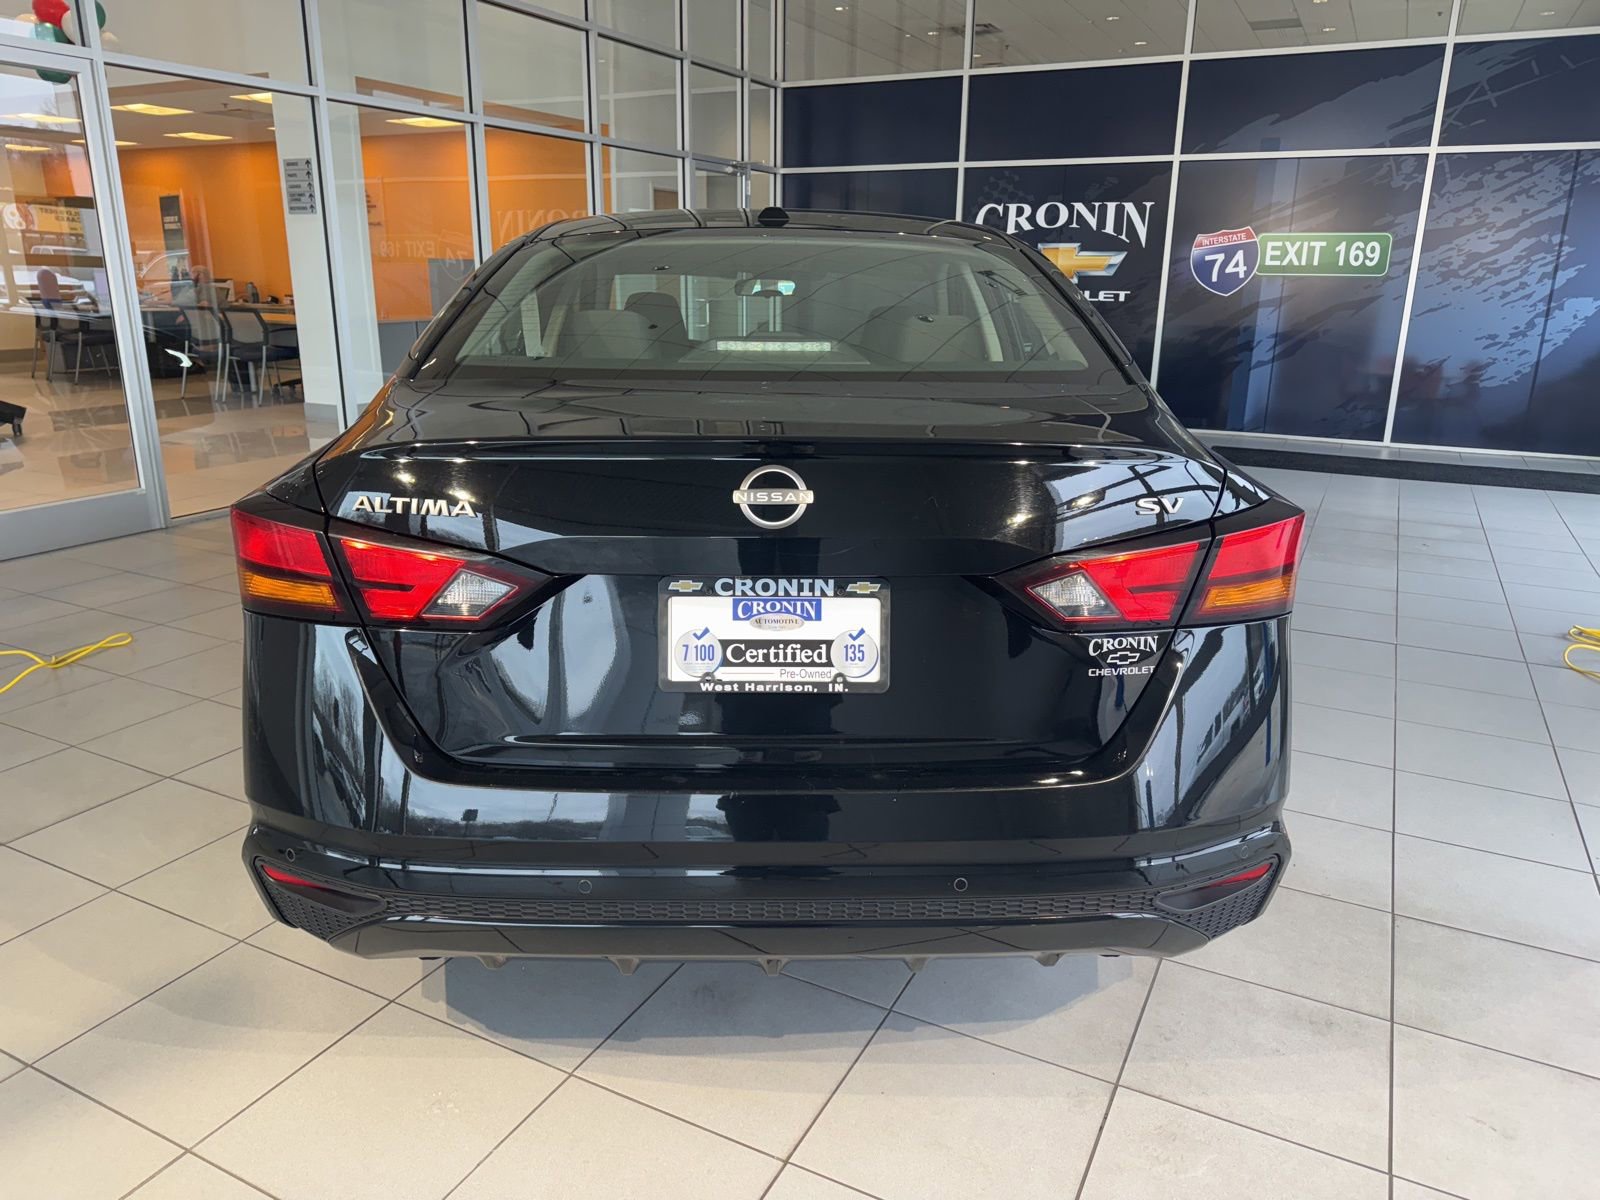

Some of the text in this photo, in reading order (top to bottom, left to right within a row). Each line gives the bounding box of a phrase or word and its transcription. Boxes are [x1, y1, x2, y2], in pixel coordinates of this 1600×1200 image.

[1202, 232, 1247, 246] INTERSTATE
[1264, 241, 1380, 267] EXIT 169
[1204, 249, 1247, 283] 74
[736, 492, 811, 502] NISSAN
[1136, 497, 1184, 515] SV
[352, 495, 478, 518] ALTIMA
[714, 578, 835, 597] CRONIN
[737, 600, 817, 621] CRONIN
[694, 644, 715, 662] 100
[726, 643, 829, 664] Certified
[843, 644, 865, 662] 135
[1088, 635, 1159, 657] CRONIN
[780, 668, 832, 679] Pre-Owned
[1088, 665, 1157, 677] CHEVROLET
[700, 682, 849, 693] West Harrison, IN.
